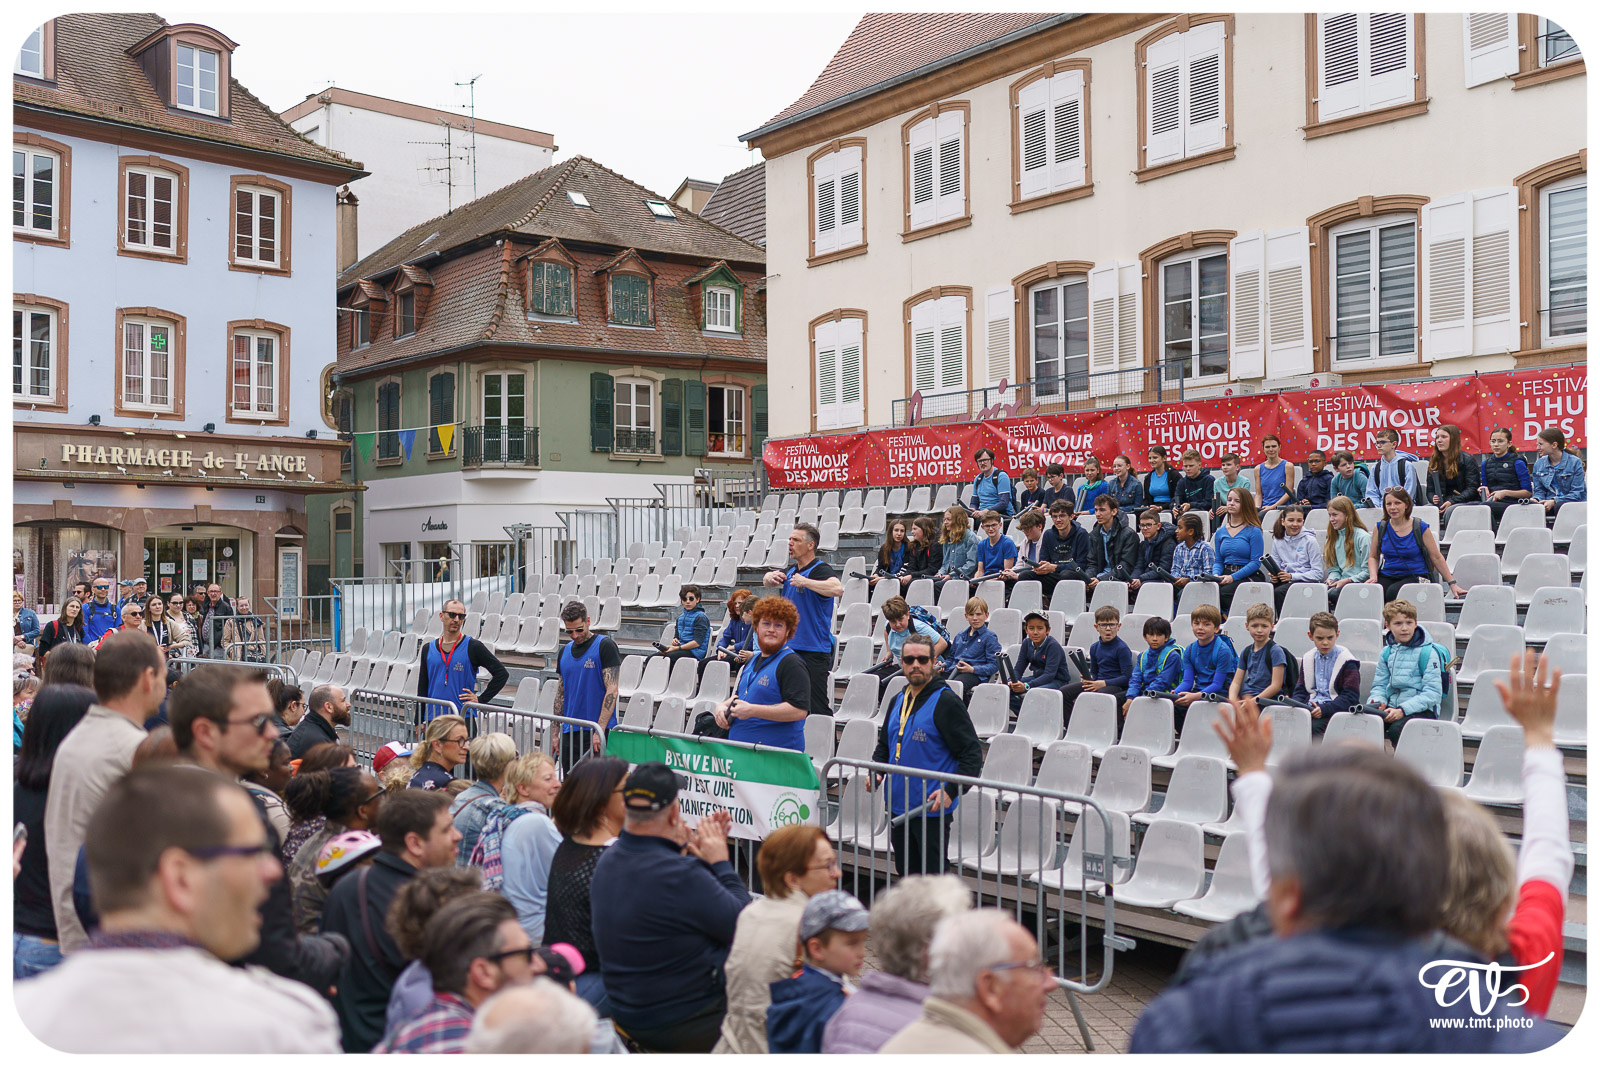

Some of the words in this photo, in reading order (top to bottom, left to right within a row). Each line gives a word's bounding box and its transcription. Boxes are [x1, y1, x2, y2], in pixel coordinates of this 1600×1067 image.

[1317, 395, 1383, 412] FESTIVAL
[1148, 410, 1200, 426] FESTIVAL
[1317, 407, 1441, 432] L'HUMOUR
[1008, 424, 1051, 437] FESTIVAL
[1148, 421, 1250, 444] L'HUMOUR
[1317, 432, 1358, 451] DES
[1366, 428, 1440, 450] NTE
[786, 444, 820, 455] FESTIVAL
[888, 434, 927, 447] FESTIVAL
[1006, 433, 1093, 453] L'HUMOUR
[61, 443, 193, 468] PHARMACIE
[202, 451, 225, 469] de
[255, 454, 307, 472] ANGE
[783, 453, 849, 469] L'HUMOUR
[889, 444, 962, 462] L'HUMOUR
[1008, 453, 1035, 470] DES
[1148, 444, 1182, 461] ES
[784, 470, 808, 483] DES
[811, 467, 849, 482] NOTES
[890, 462, 914, 478] DES
[917, 460, 962, 477] NOTES
[665, 749, 737, 779] BIENVENUE,
[695, 778, 710, 795] EST
[713, 780, 735, 798] UNE
[678, 797, 753, 825] MANIFESTTION
